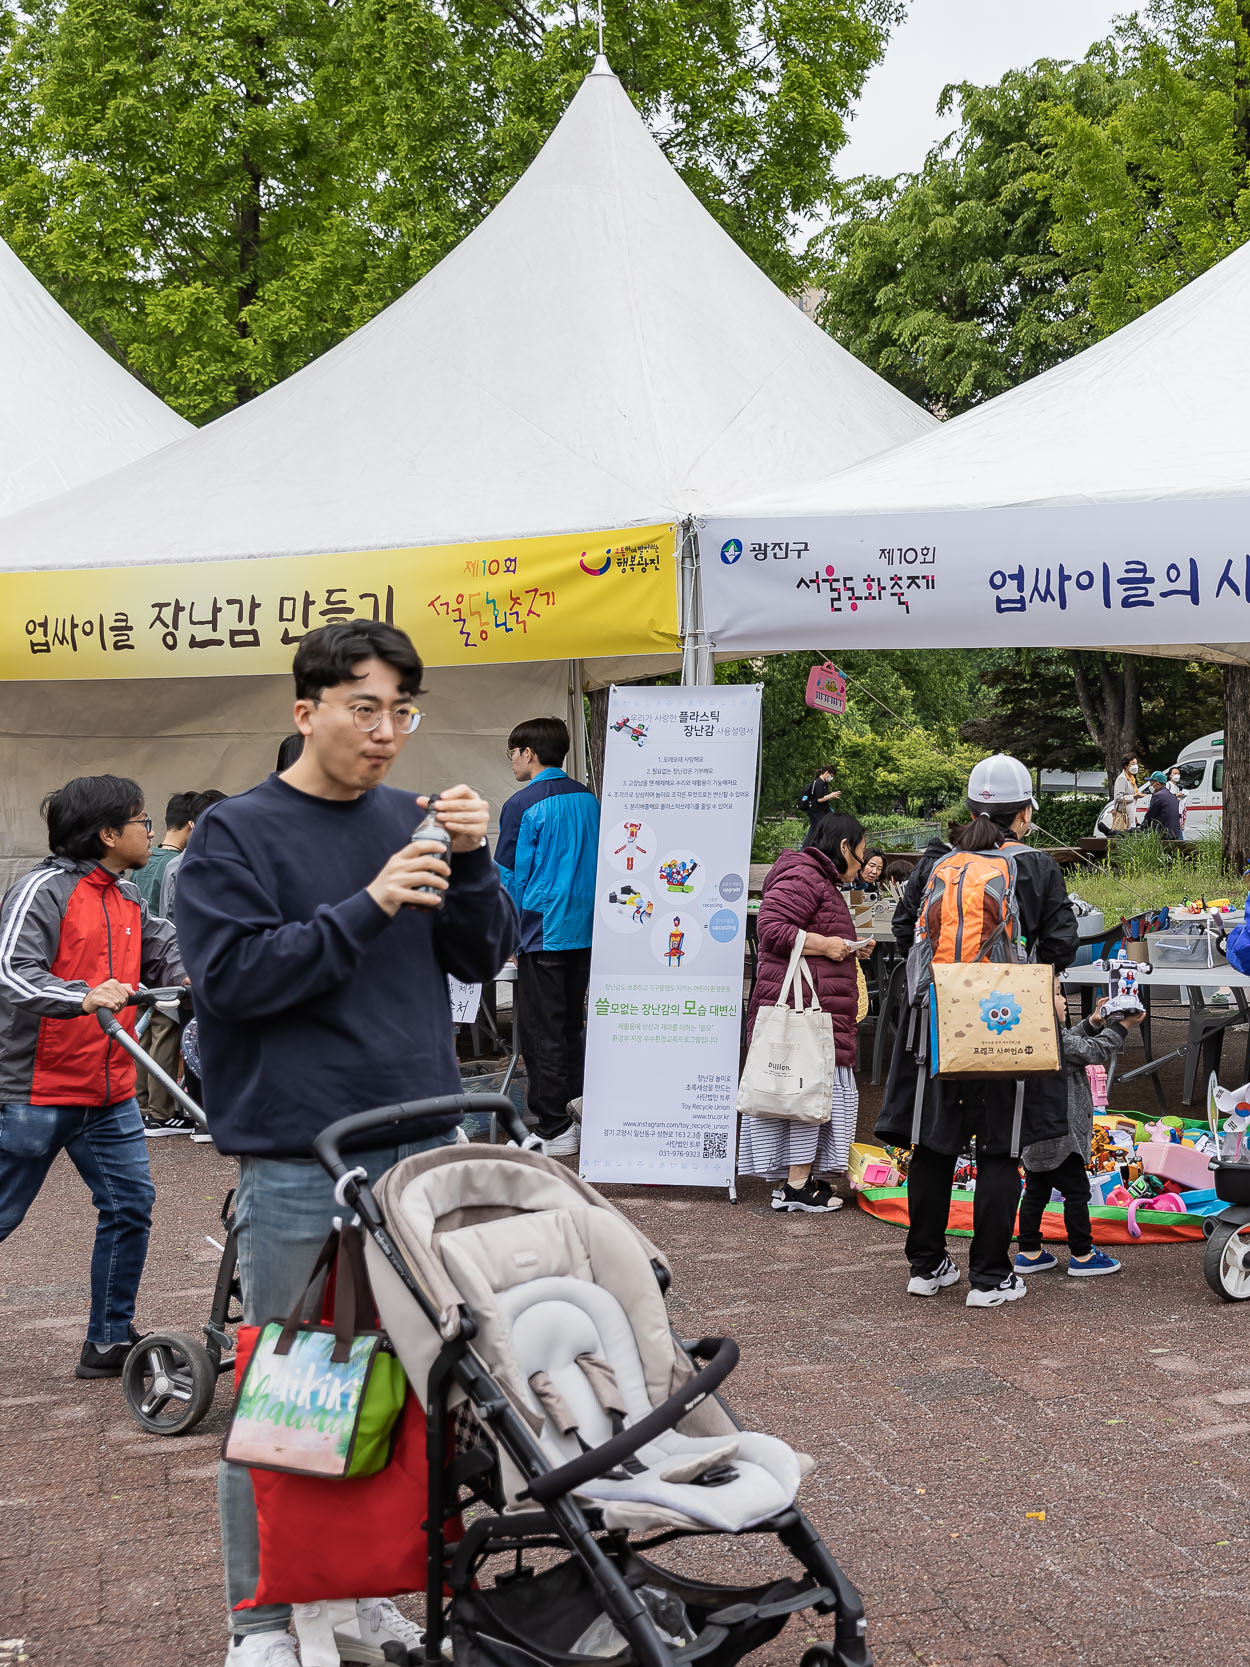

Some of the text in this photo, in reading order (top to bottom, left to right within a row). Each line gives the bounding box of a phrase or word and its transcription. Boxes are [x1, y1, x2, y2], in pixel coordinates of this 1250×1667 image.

[749, 541, 810, 561] 광진구
[878, 546, 936, 565] 제10회
[464, 556, 517, 577] 제10회
[616, 554, 660, 574] 행복광진
[796, 565, 936, 614] 서울동화축제
[989, 557, 1199, 613] 업싸이클의
[25, 612, 135, 654] 업싸이클
[149, 594, 261, 650] 장난감
[428, 588, 555, 647] 서울동화축제
[630, 711, 720, 723] 우리가 사랑한 플라스틱
[684, 725, 754, 737] 장난감 사용설명서
[595, 997, 737, 1017] 쓸모없는 장난감의 모습 대변신
[681, 1102, 691, 1110] Toy
[692, 1103, 713, 1111] Recycle
